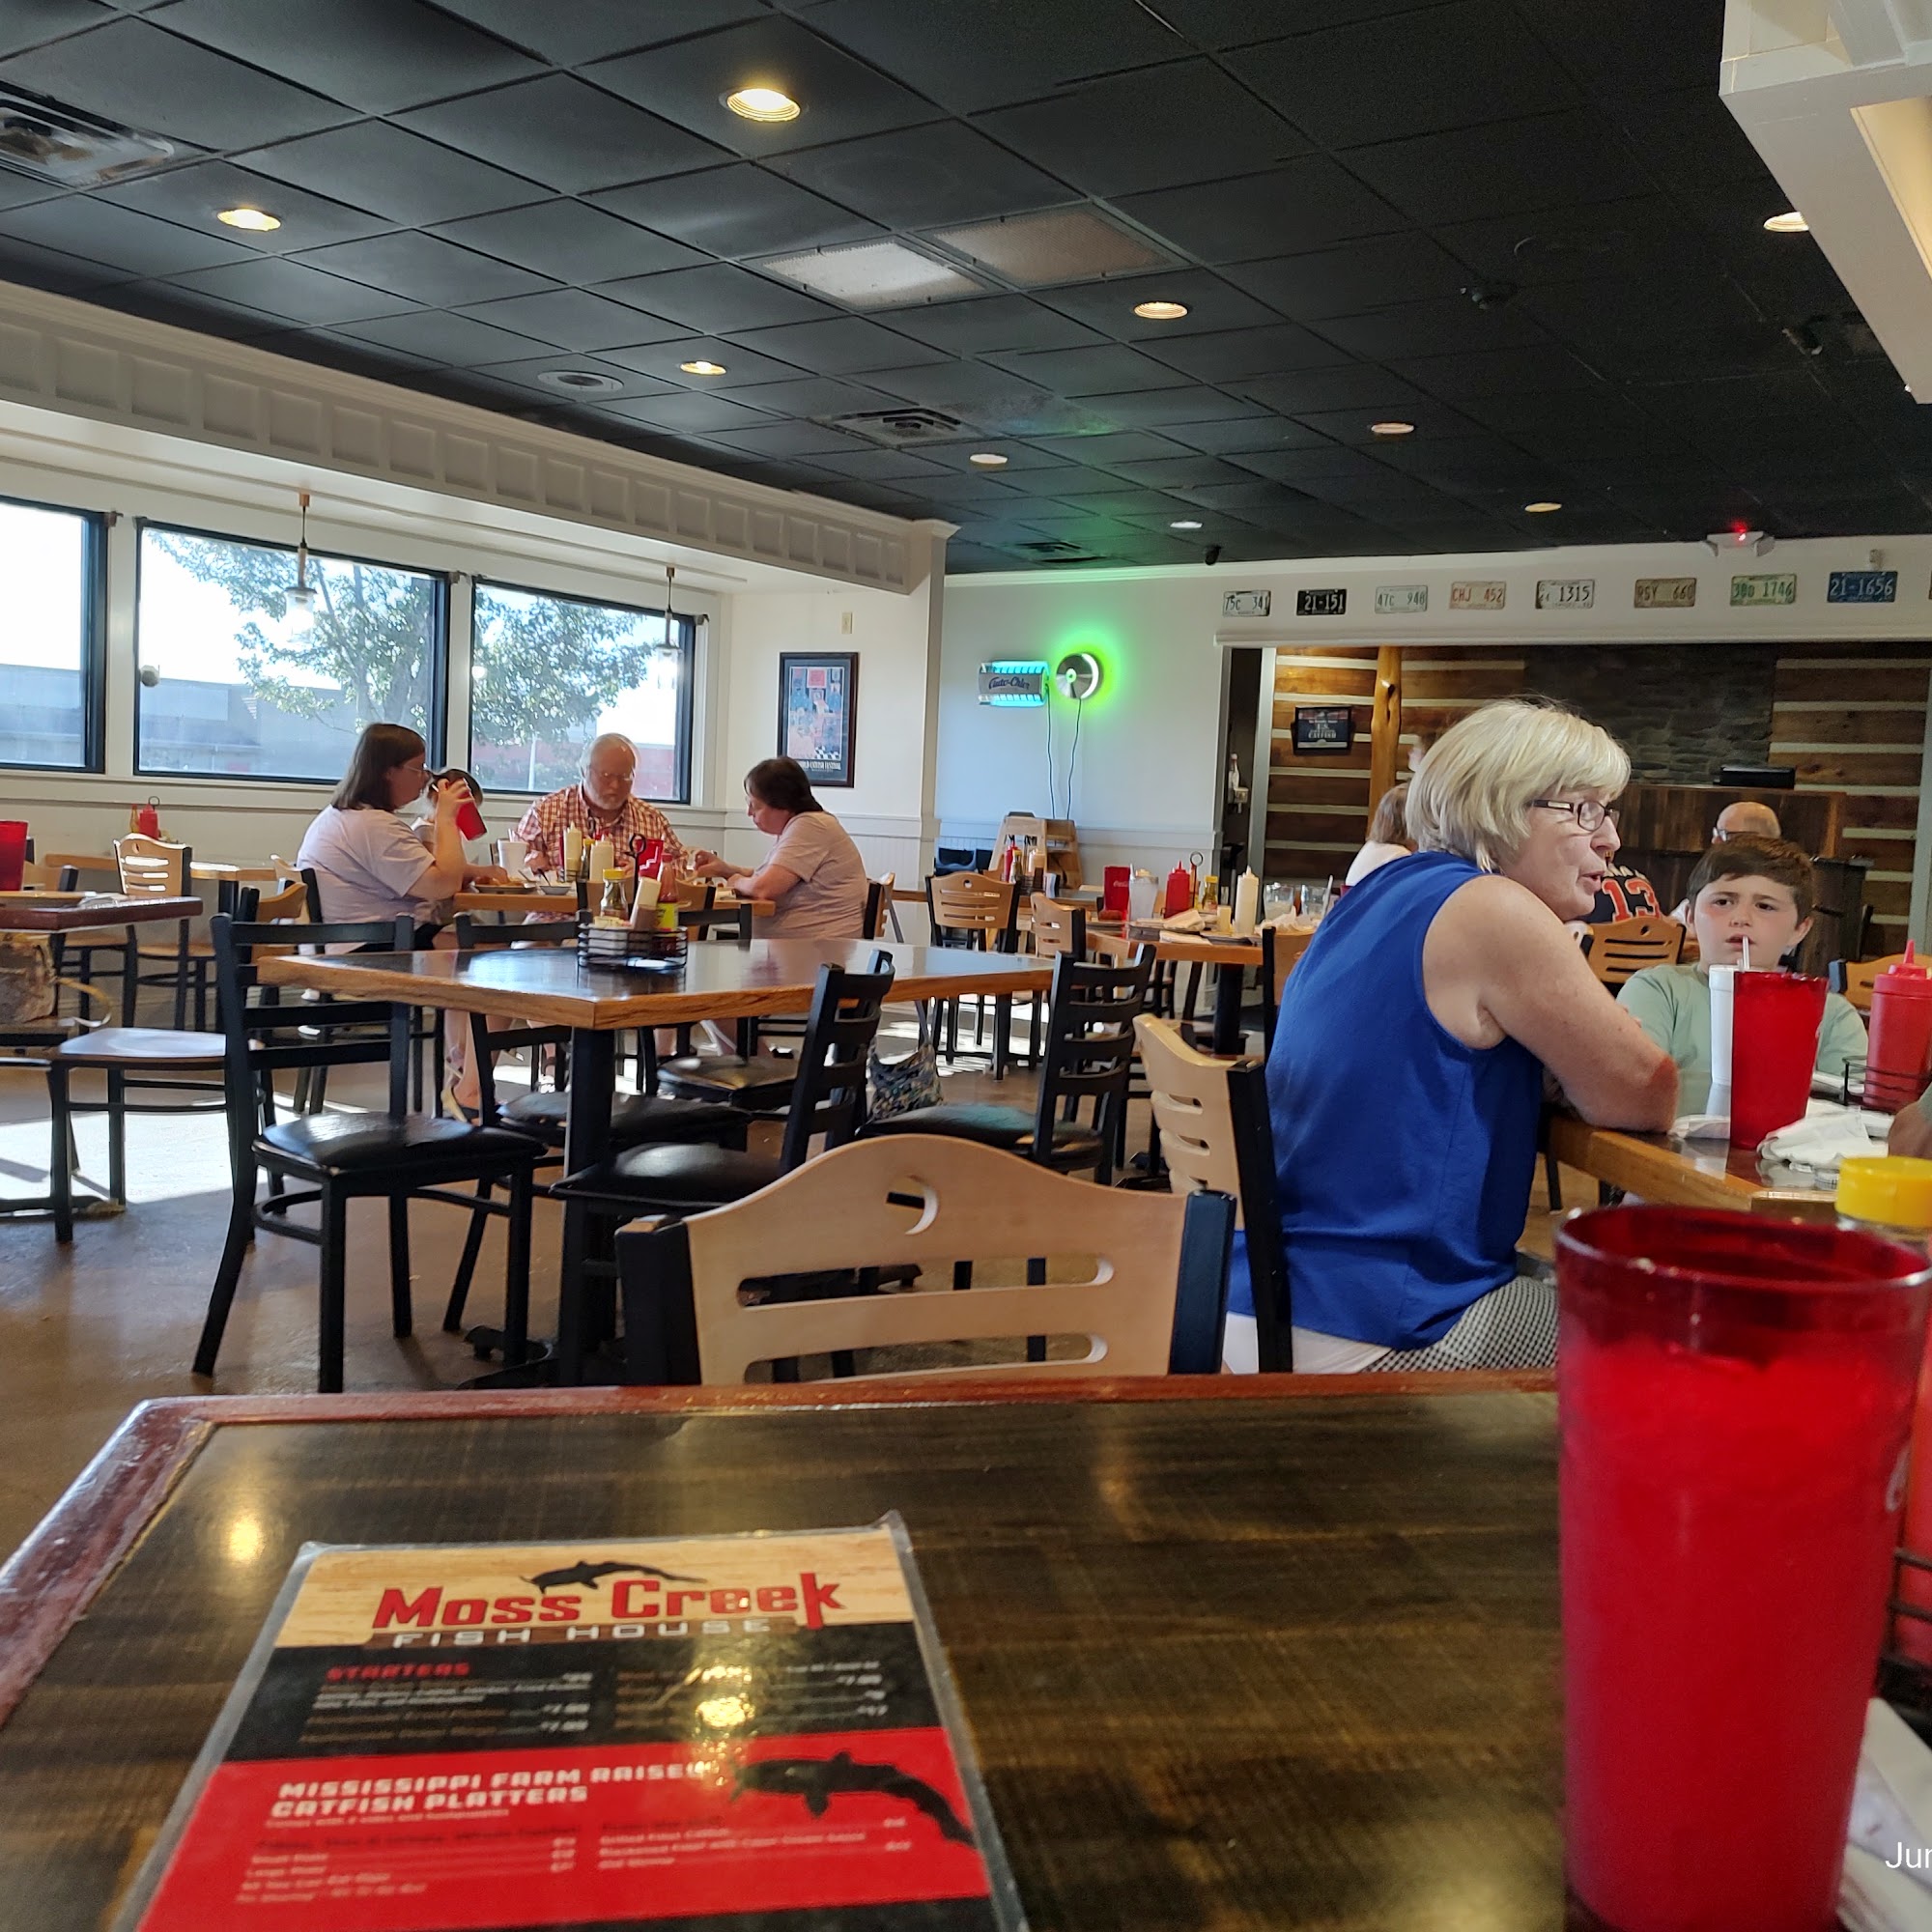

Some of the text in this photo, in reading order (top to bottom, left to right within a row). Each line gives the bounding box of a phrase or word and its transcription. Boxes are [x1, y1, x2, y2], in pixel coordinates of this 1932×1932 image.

[1304, 594, 1344, 611] 21-151
[1452, 587, 1503, 604] CHJ 452
[1559, 584, 1591, 603] 1315
[1830, 577, 1894, 597] 21-1656
[1602, 878, 1661, 923] 13
[371, 1572, 847, 1630] Moss Creek
[392, 1617, 771, 1649] FISH HOUSE
[278, 1774, 482, 1799] MISSISSIPPI
[490, 1768, 581, 1788] FARM
[270, 1786, 587, 1818] CATFISH PLATTERS
